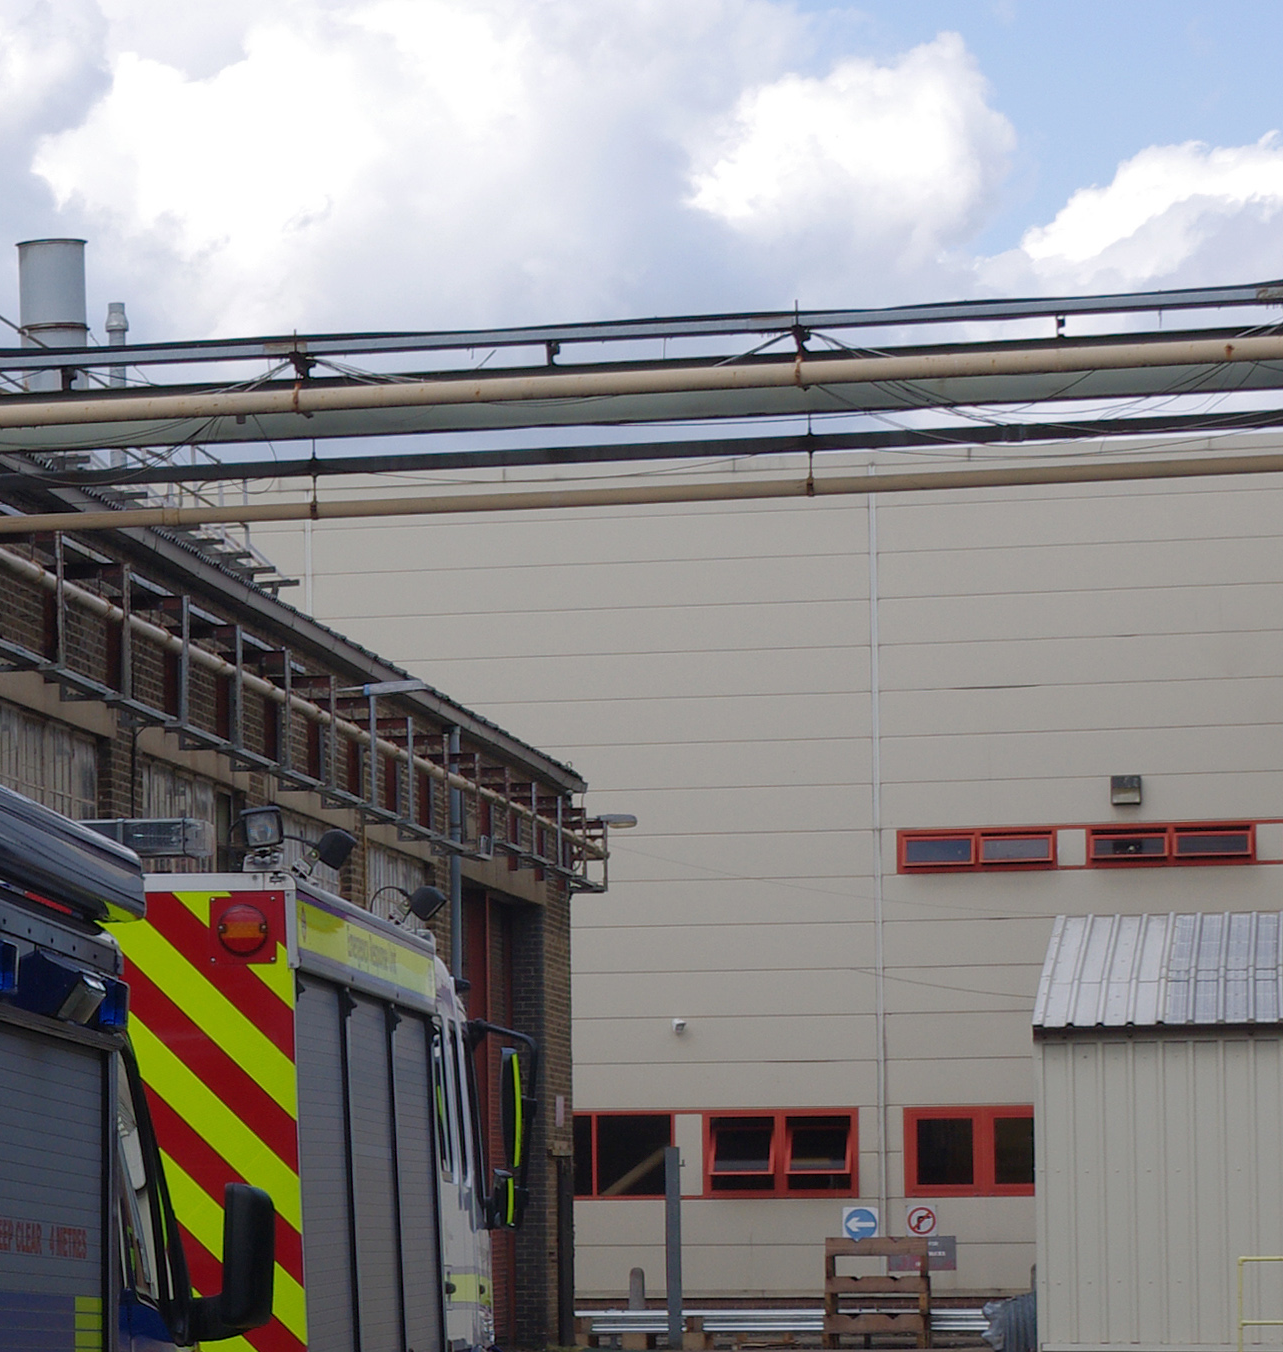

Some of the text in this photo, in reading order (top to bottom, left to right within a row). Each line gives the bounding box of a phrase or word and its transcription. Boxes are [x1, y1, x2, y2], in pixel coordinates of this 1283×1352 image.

[15, 1221, 42, 1255] CLEAR
[49, 1225, 55, 1255] 4
[56, 1226, 87, 1259] METRES
